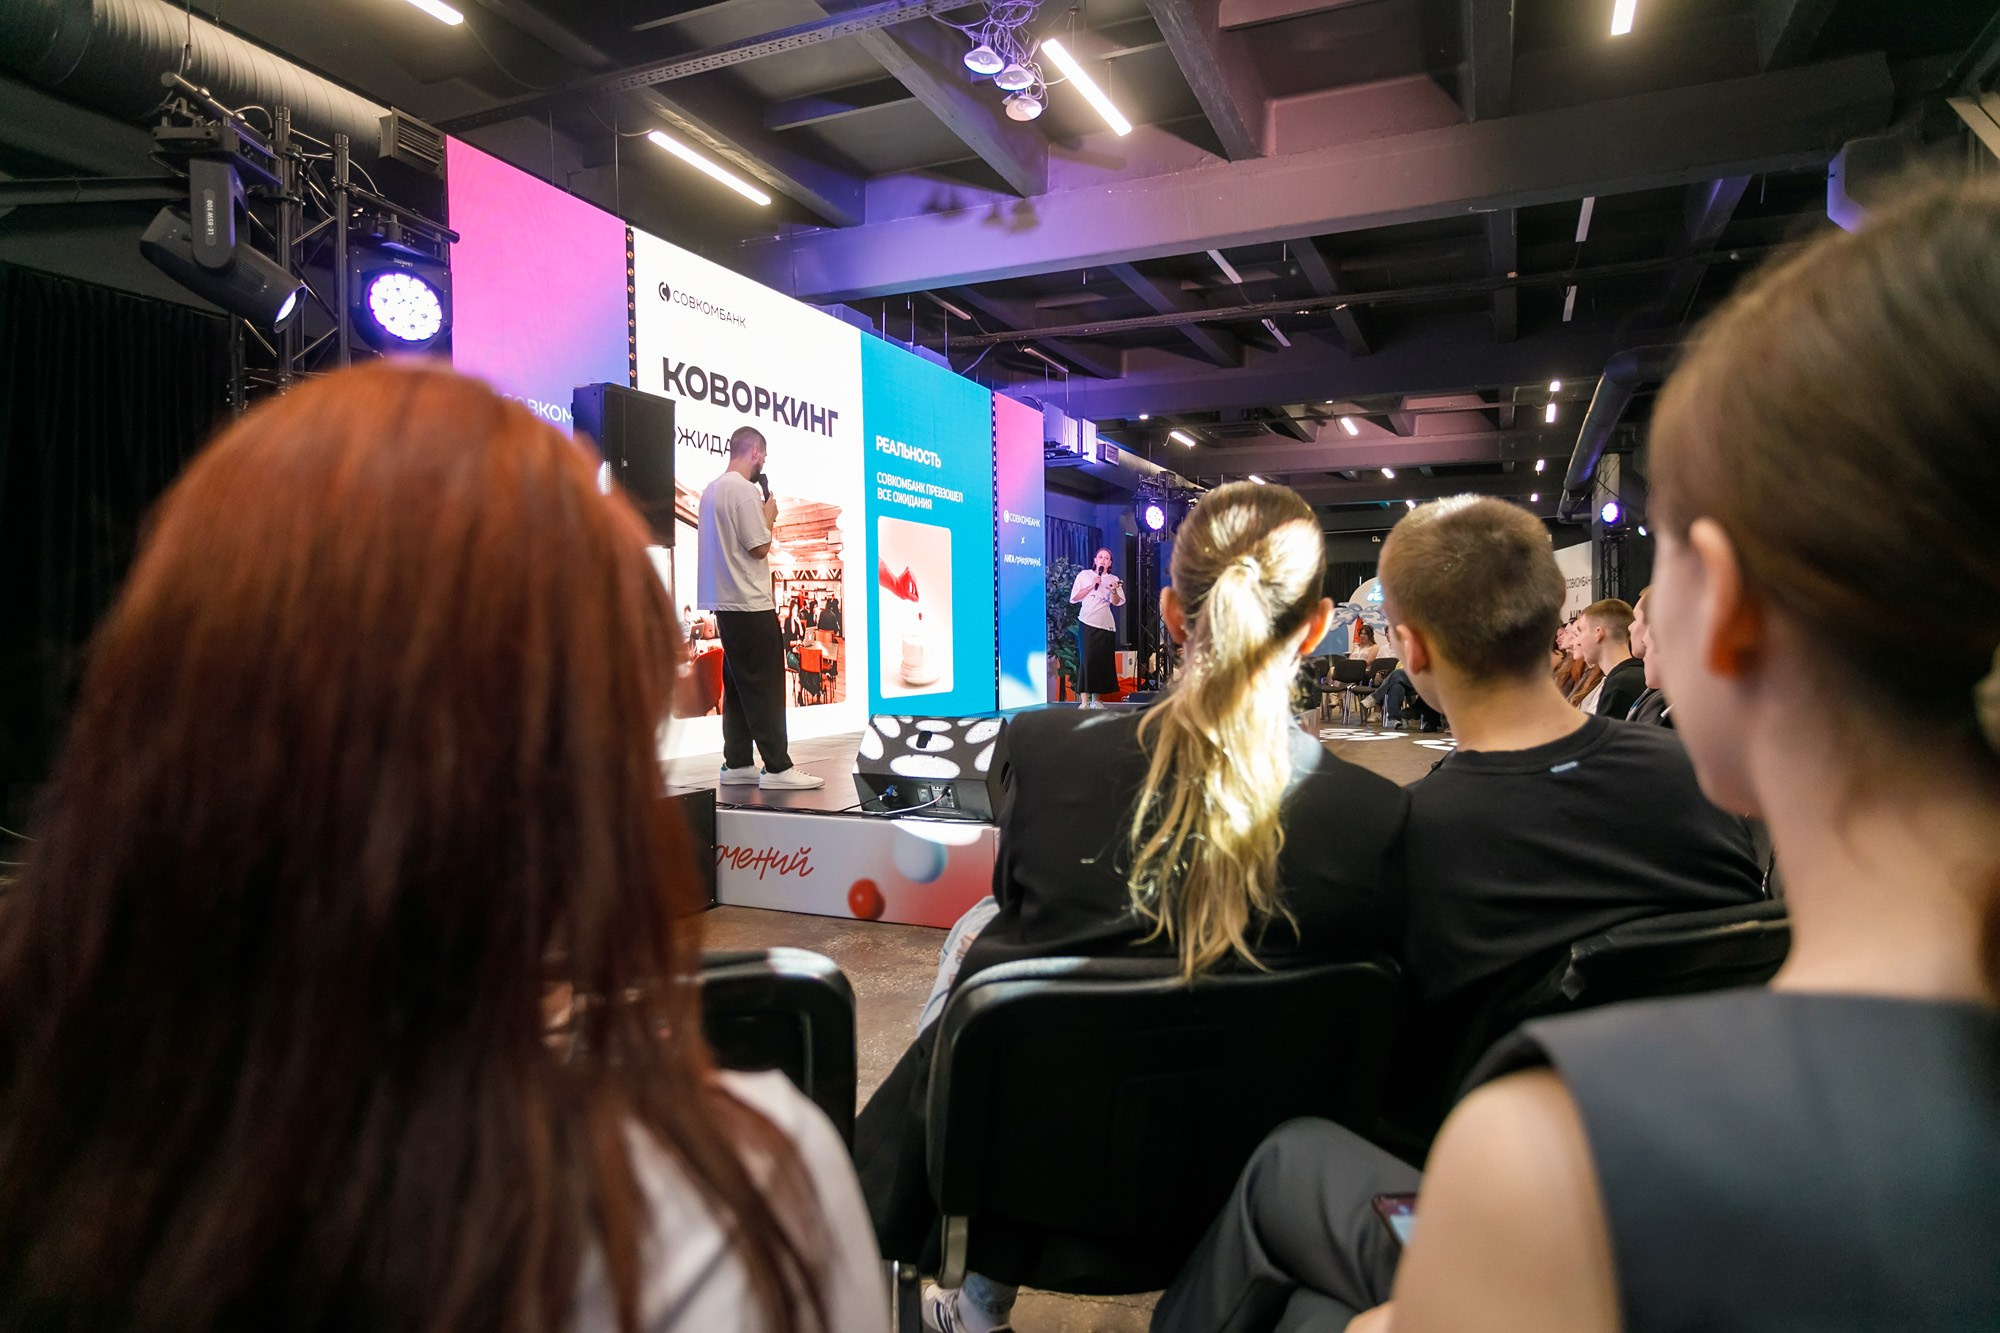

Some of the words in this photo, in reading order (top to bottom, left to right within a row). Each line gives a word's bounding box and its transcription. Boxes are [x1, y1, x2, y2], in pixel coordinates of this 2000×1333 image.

[672, 289, 747, 329] СОВКОМБАНК
[663, 356, 839, 438] КОВОРКИНГ
[674, 426, 731, 457] ЖИДА
[876, 435, 942, 468] РЕАЛЬНОСТЬ
[876, 471, 926, 495] СОВКОМБАНК
[926, 483, 964, 504] ПРЕВЗОШЕЛ
[877, 488, 892, 502] ВСЕ
[893, 491, 933, 510] ОЖИДАНИЯ
